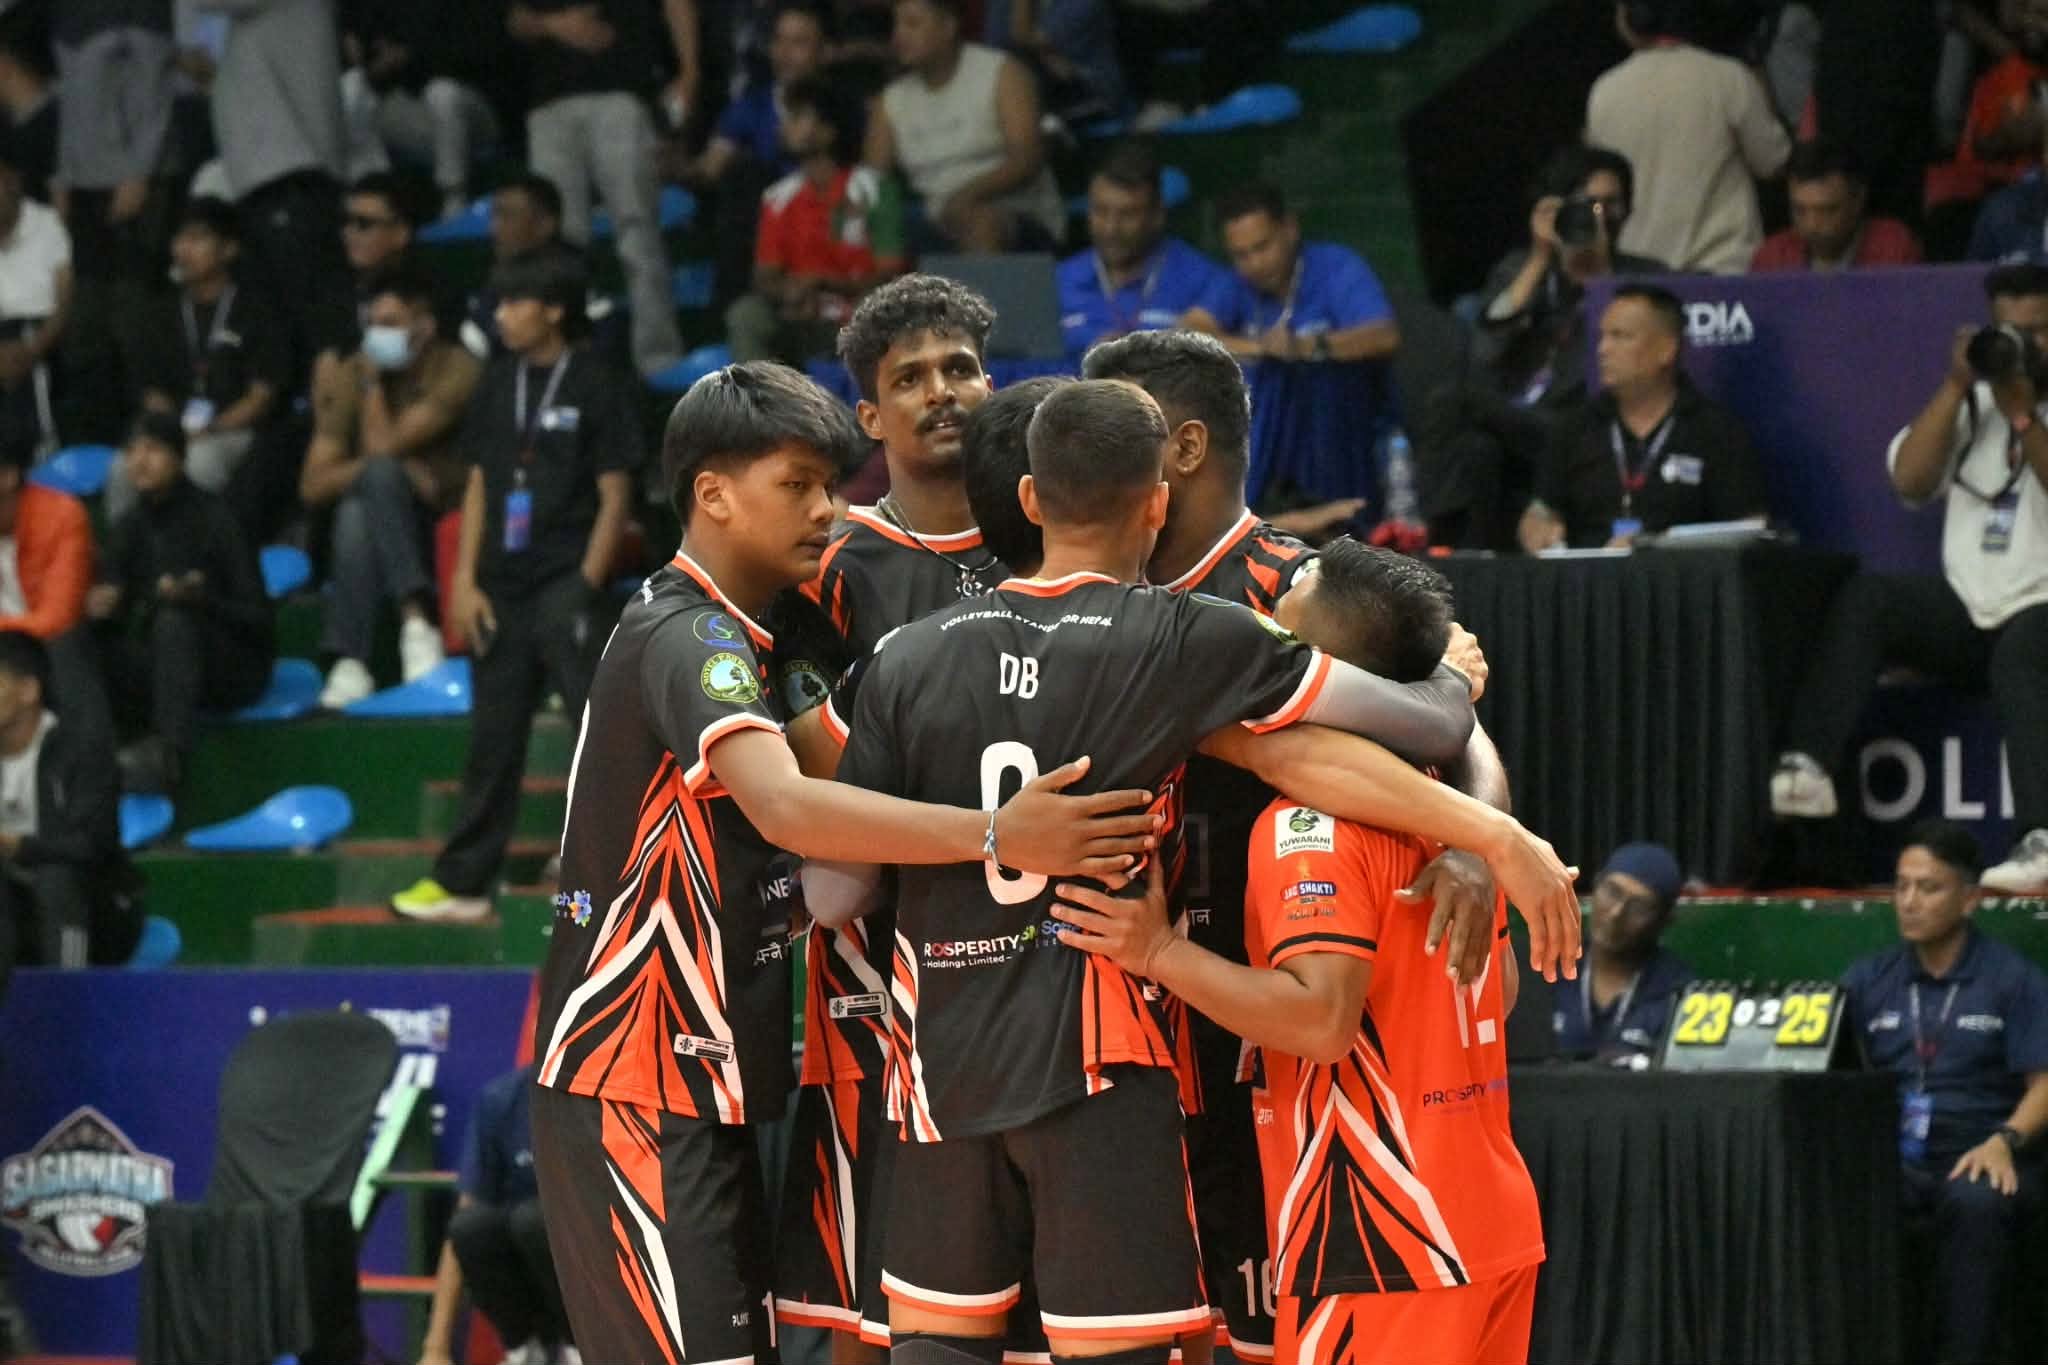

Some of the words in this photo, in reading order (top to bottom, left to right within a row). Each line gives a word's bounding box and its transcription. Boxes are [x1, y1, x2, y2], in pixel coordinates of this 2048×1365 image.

[940, 610, 1013, 631] VOLLEYBALL
[1000, 652, 1039, 699] DB
[1279, 835, 1331, 848] YUWARANI
[1299, 882, 1334, 895] SHAKTI
[924, 934, 1020, 957] ROSPERITY
[1675, 992, 1734, 1044] 23
[1733, 999, 1756, 1027] 0
[1757, 999, 1781, 1025] 2
[1775, 992, 1832, 1044] 25
